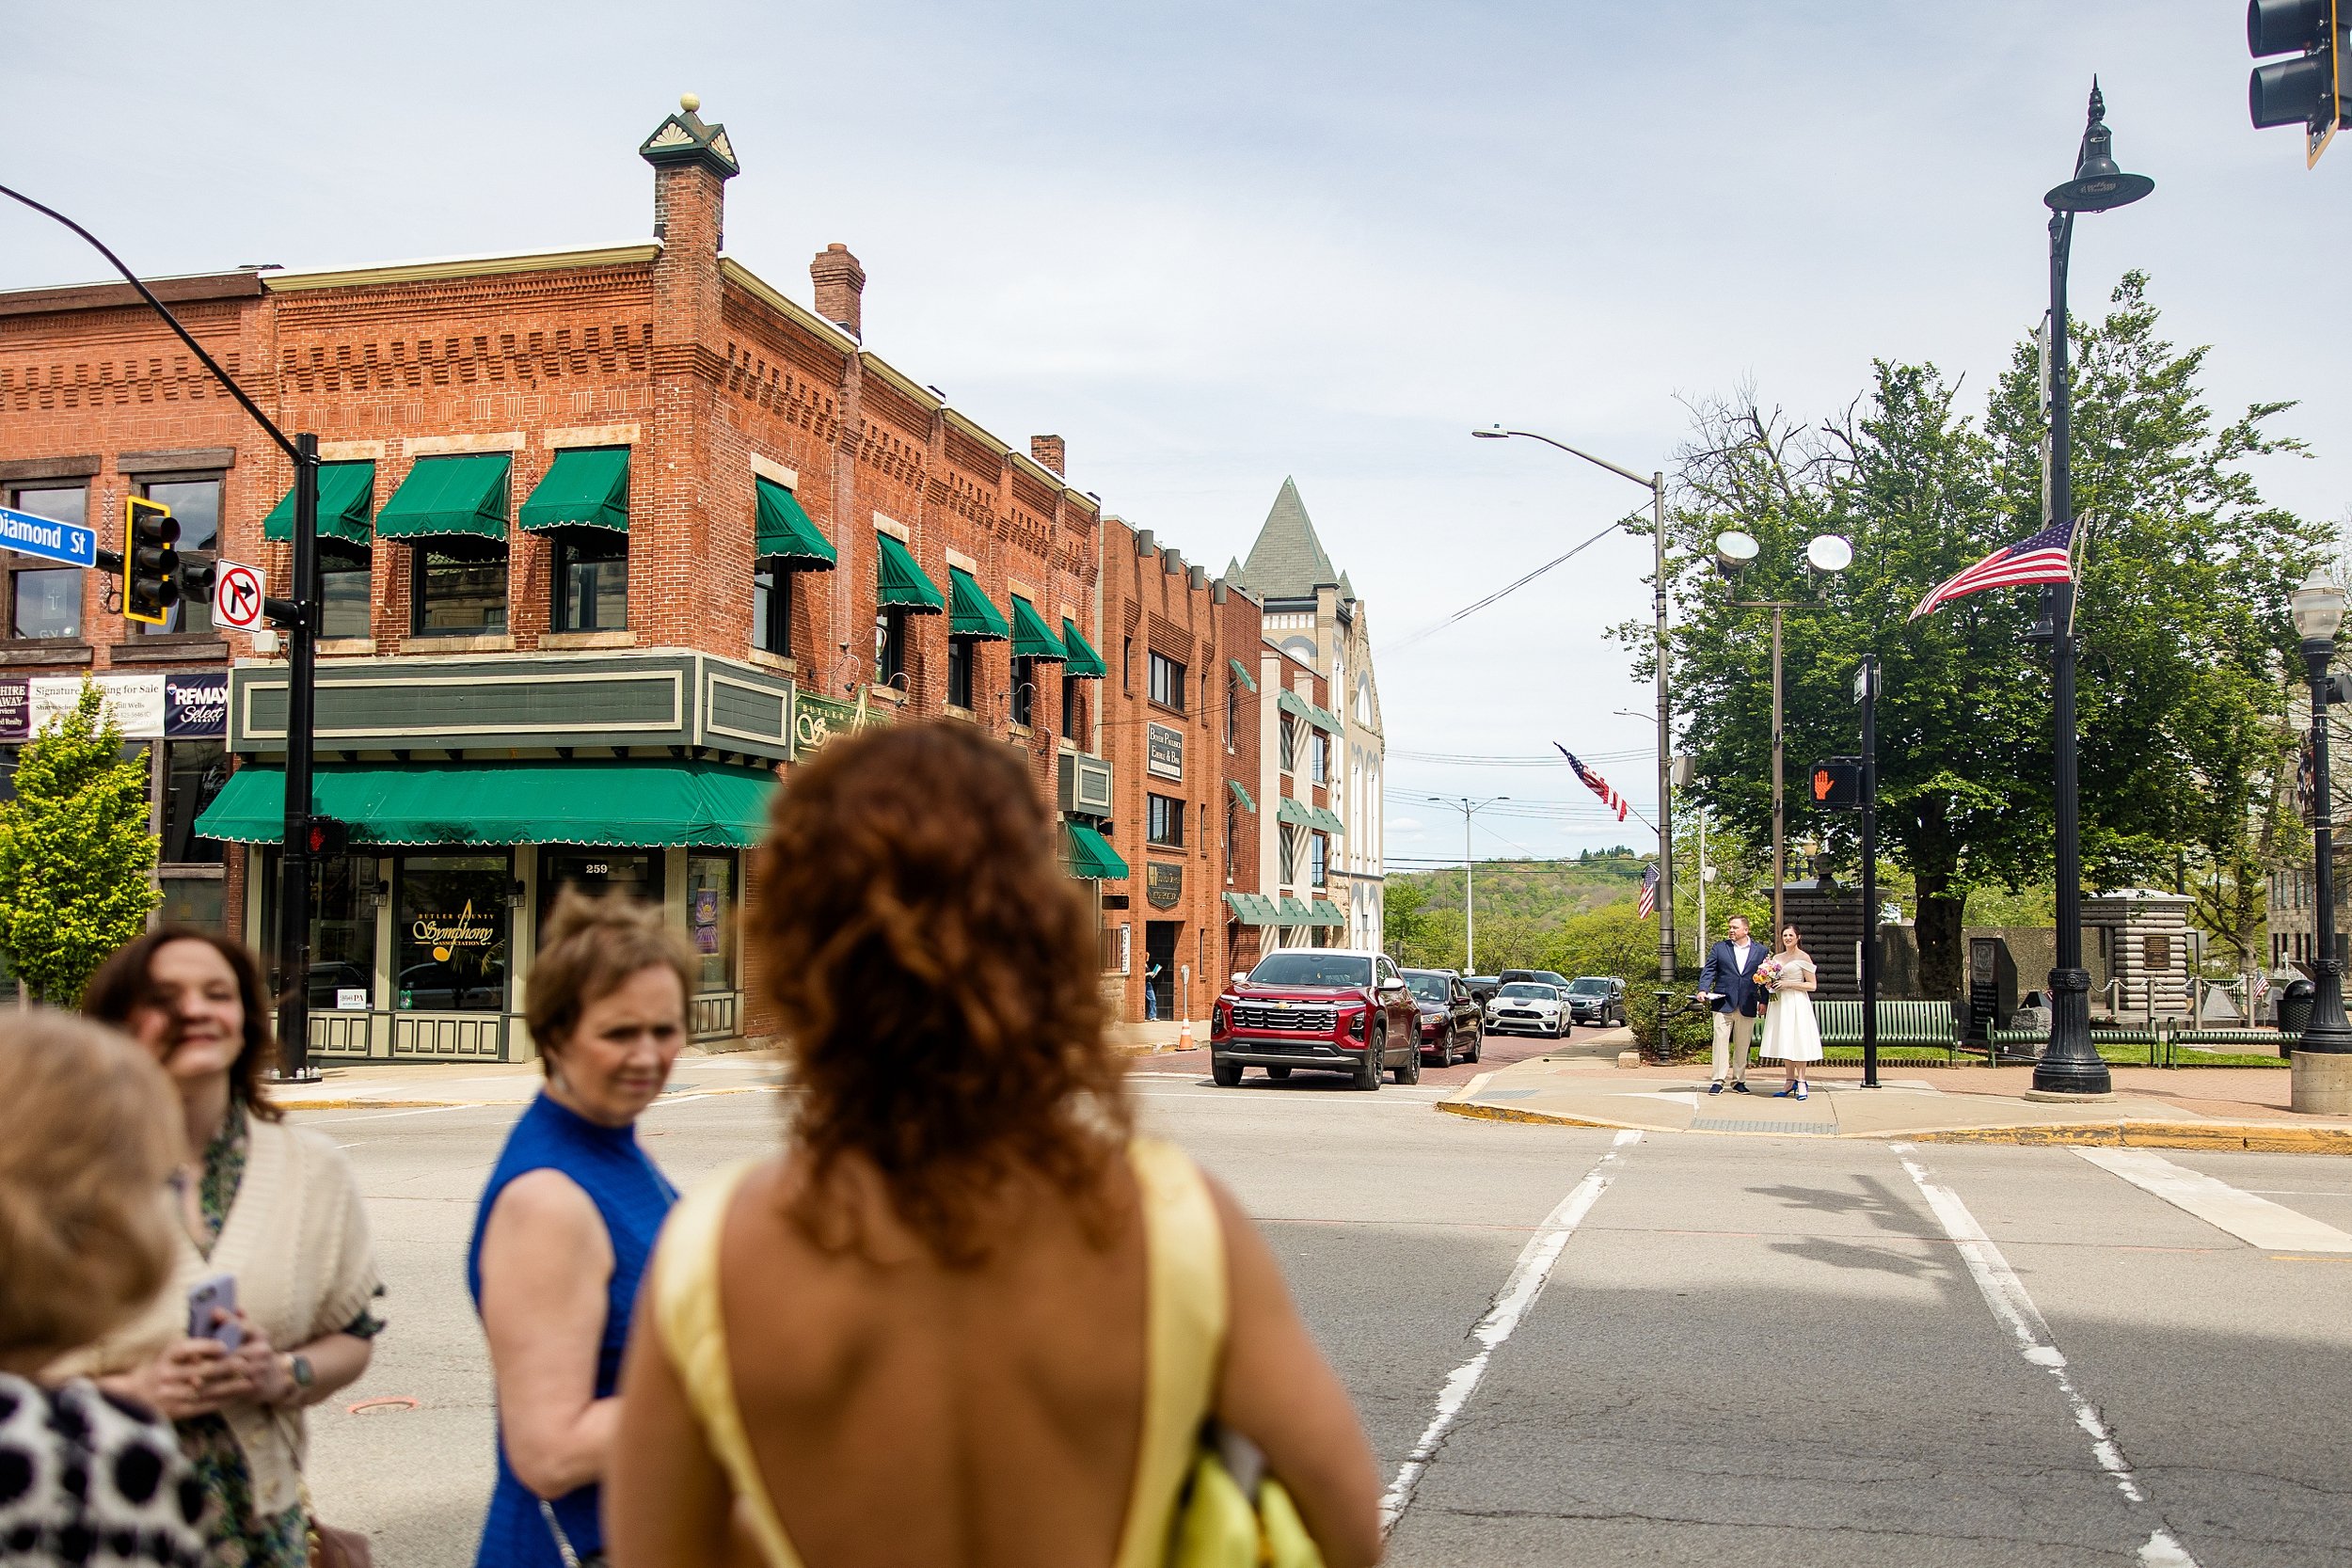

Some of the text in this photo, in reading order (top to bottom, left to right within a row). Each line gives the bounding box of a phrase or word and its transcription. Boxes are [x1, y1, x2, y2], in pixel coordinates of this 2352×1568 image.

[70, 531, 86, 554] St
[36, 687, 80, 697] Signature
[123, 685, 137, 694] for
[139, 684, 159, 693] Sale
[181, 705, 226, 723] Select
[803, 704, 845, 721] BUTLER
[586, 864, 609, 874] 259
[413, 920, 494, 945] Symphony
